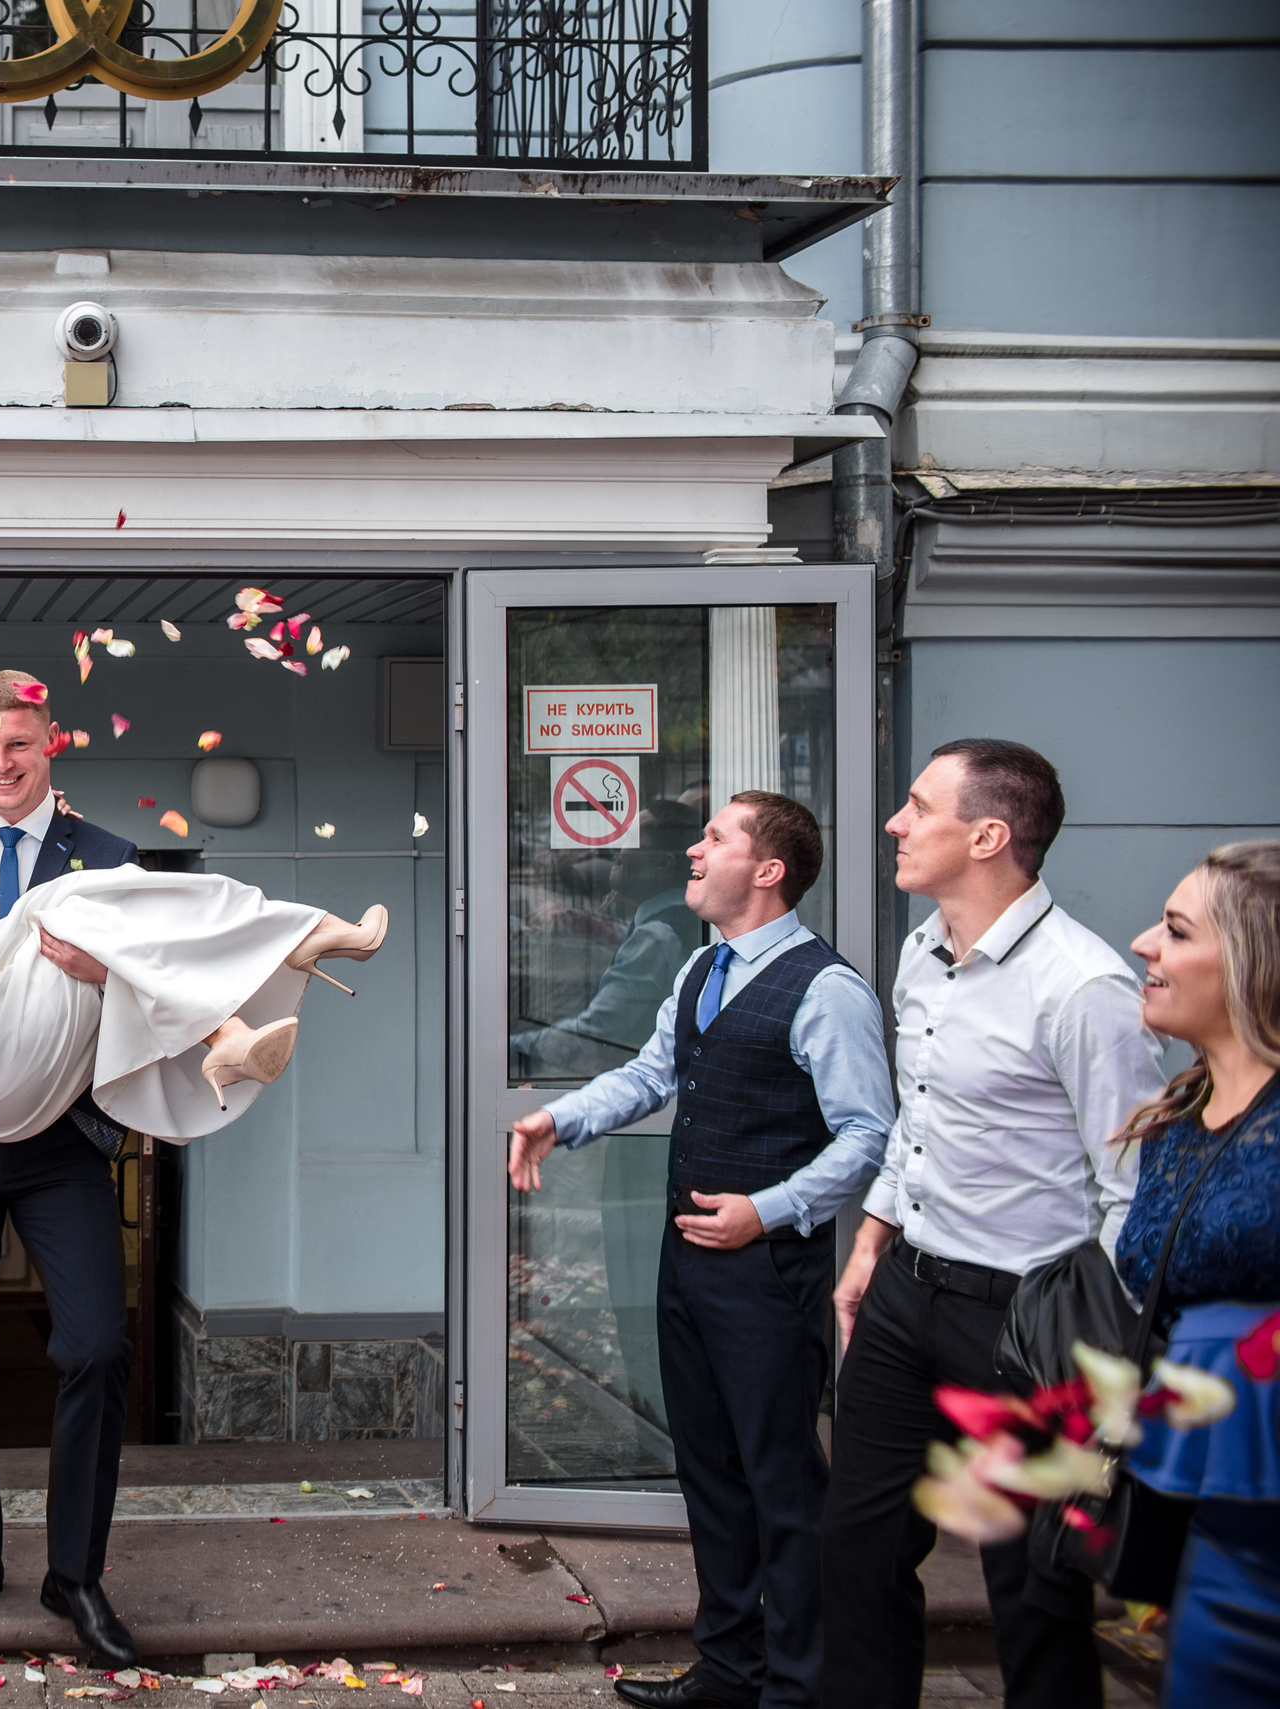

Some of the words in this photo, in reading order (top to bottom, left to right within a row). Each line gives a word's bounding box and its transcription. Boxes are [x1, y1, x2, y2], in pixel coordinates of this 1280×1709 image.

[547, 703, 567, 715] НЕ
[576, 703, 635, 715] КУРИТЬ
[540, 724, 562, 736] NO
[571, 723, 642, 736] SMOKING
